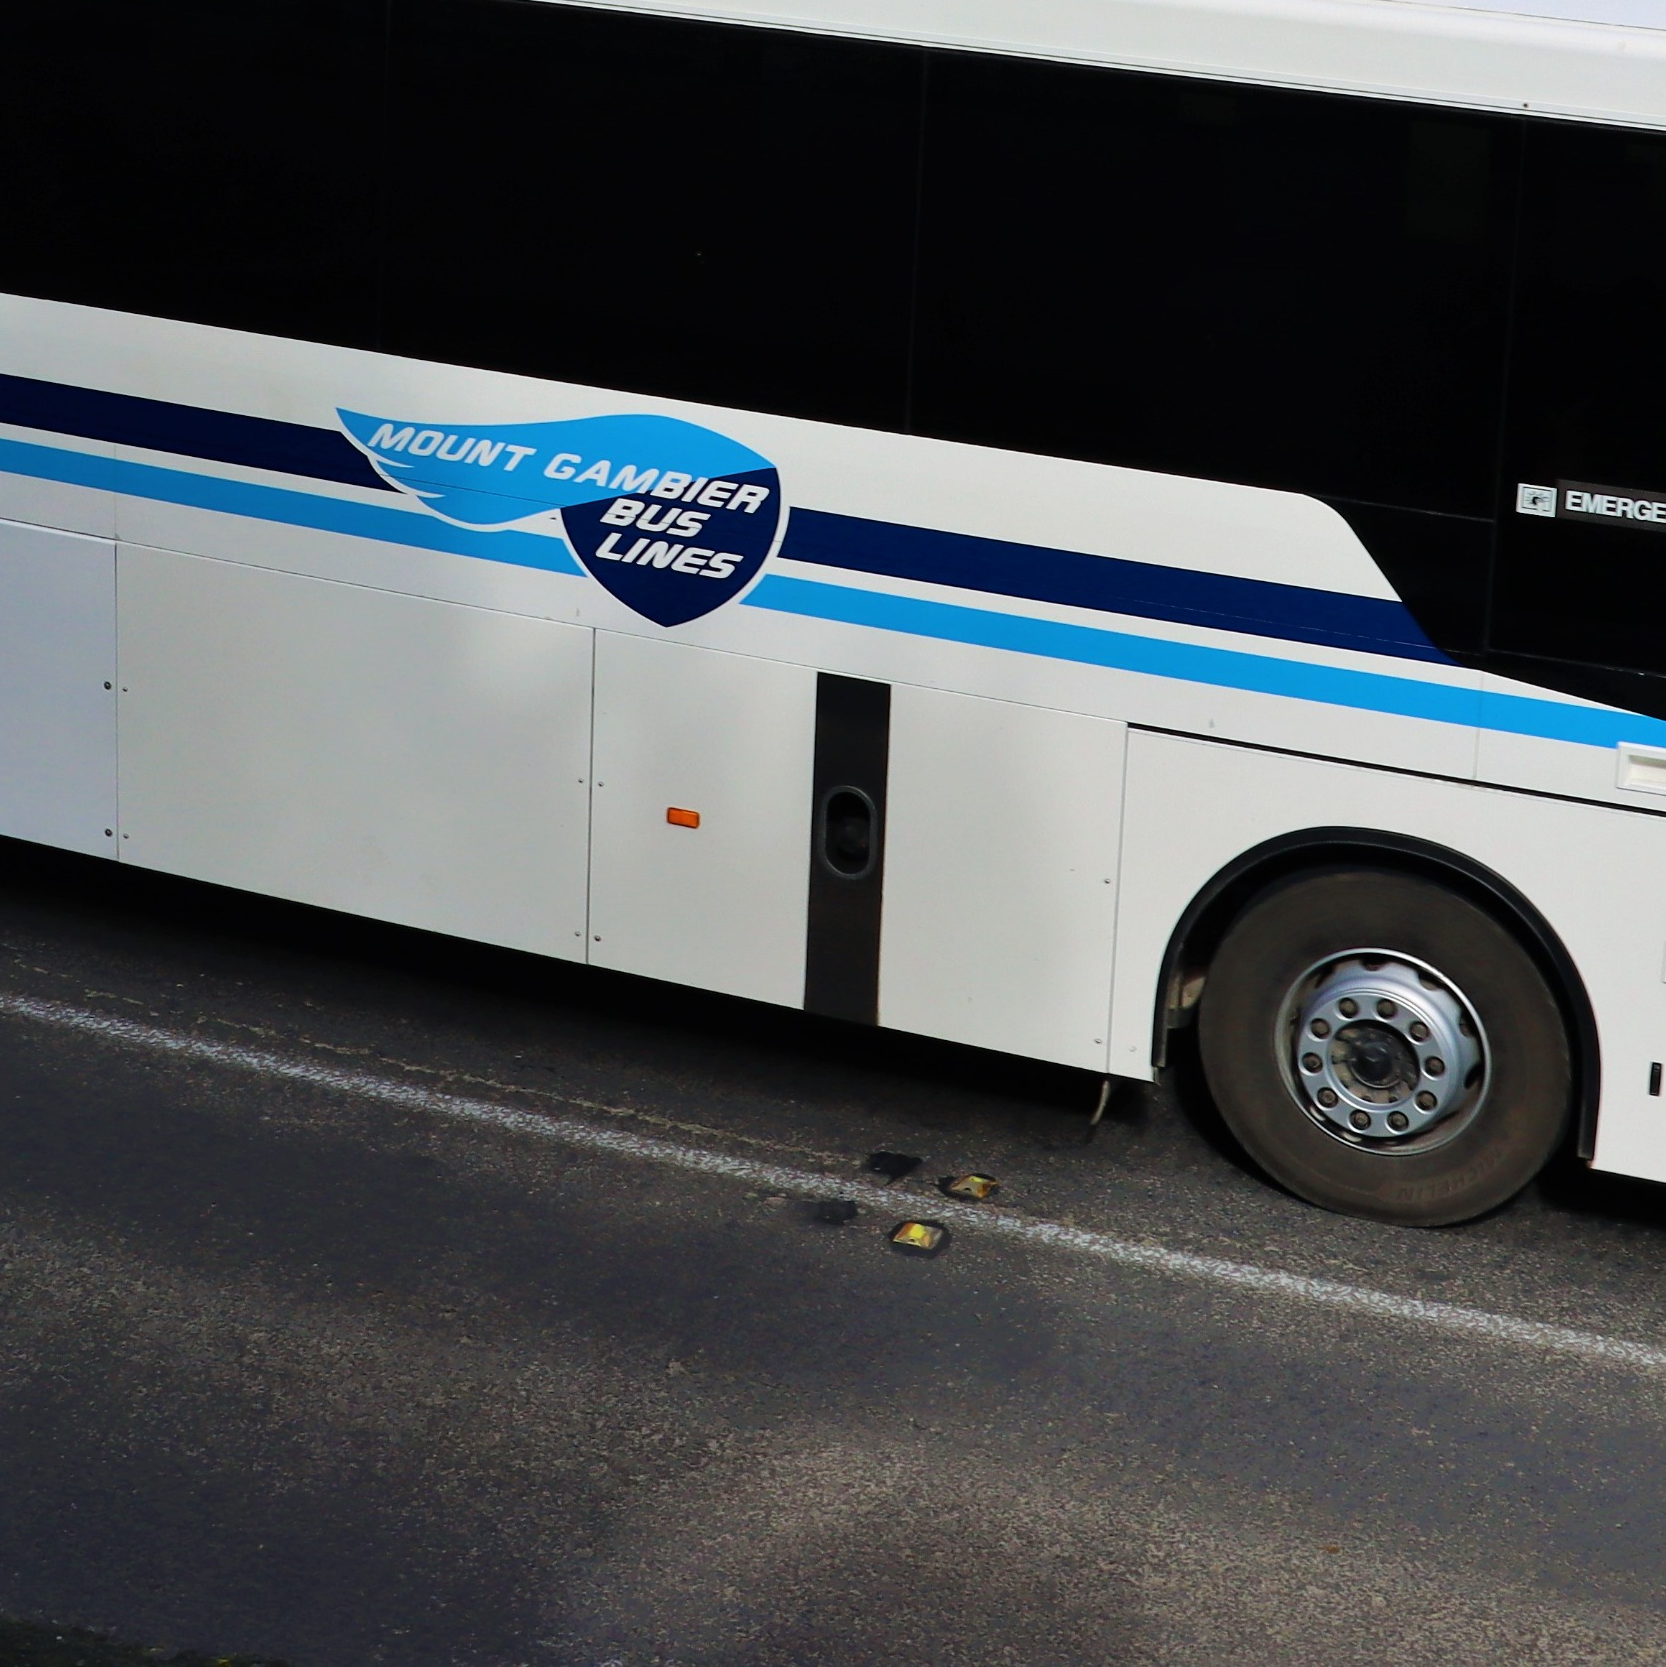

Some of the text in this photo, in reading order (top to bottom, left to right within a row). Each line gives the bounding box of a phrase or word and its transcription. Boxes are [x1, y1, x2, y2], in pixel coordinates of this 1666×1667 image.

[366, 423, 770, 514] MOUNT GAMBIER
[599, 498, 711, 537] BUS
[594, 532, 744, 579] LINES
